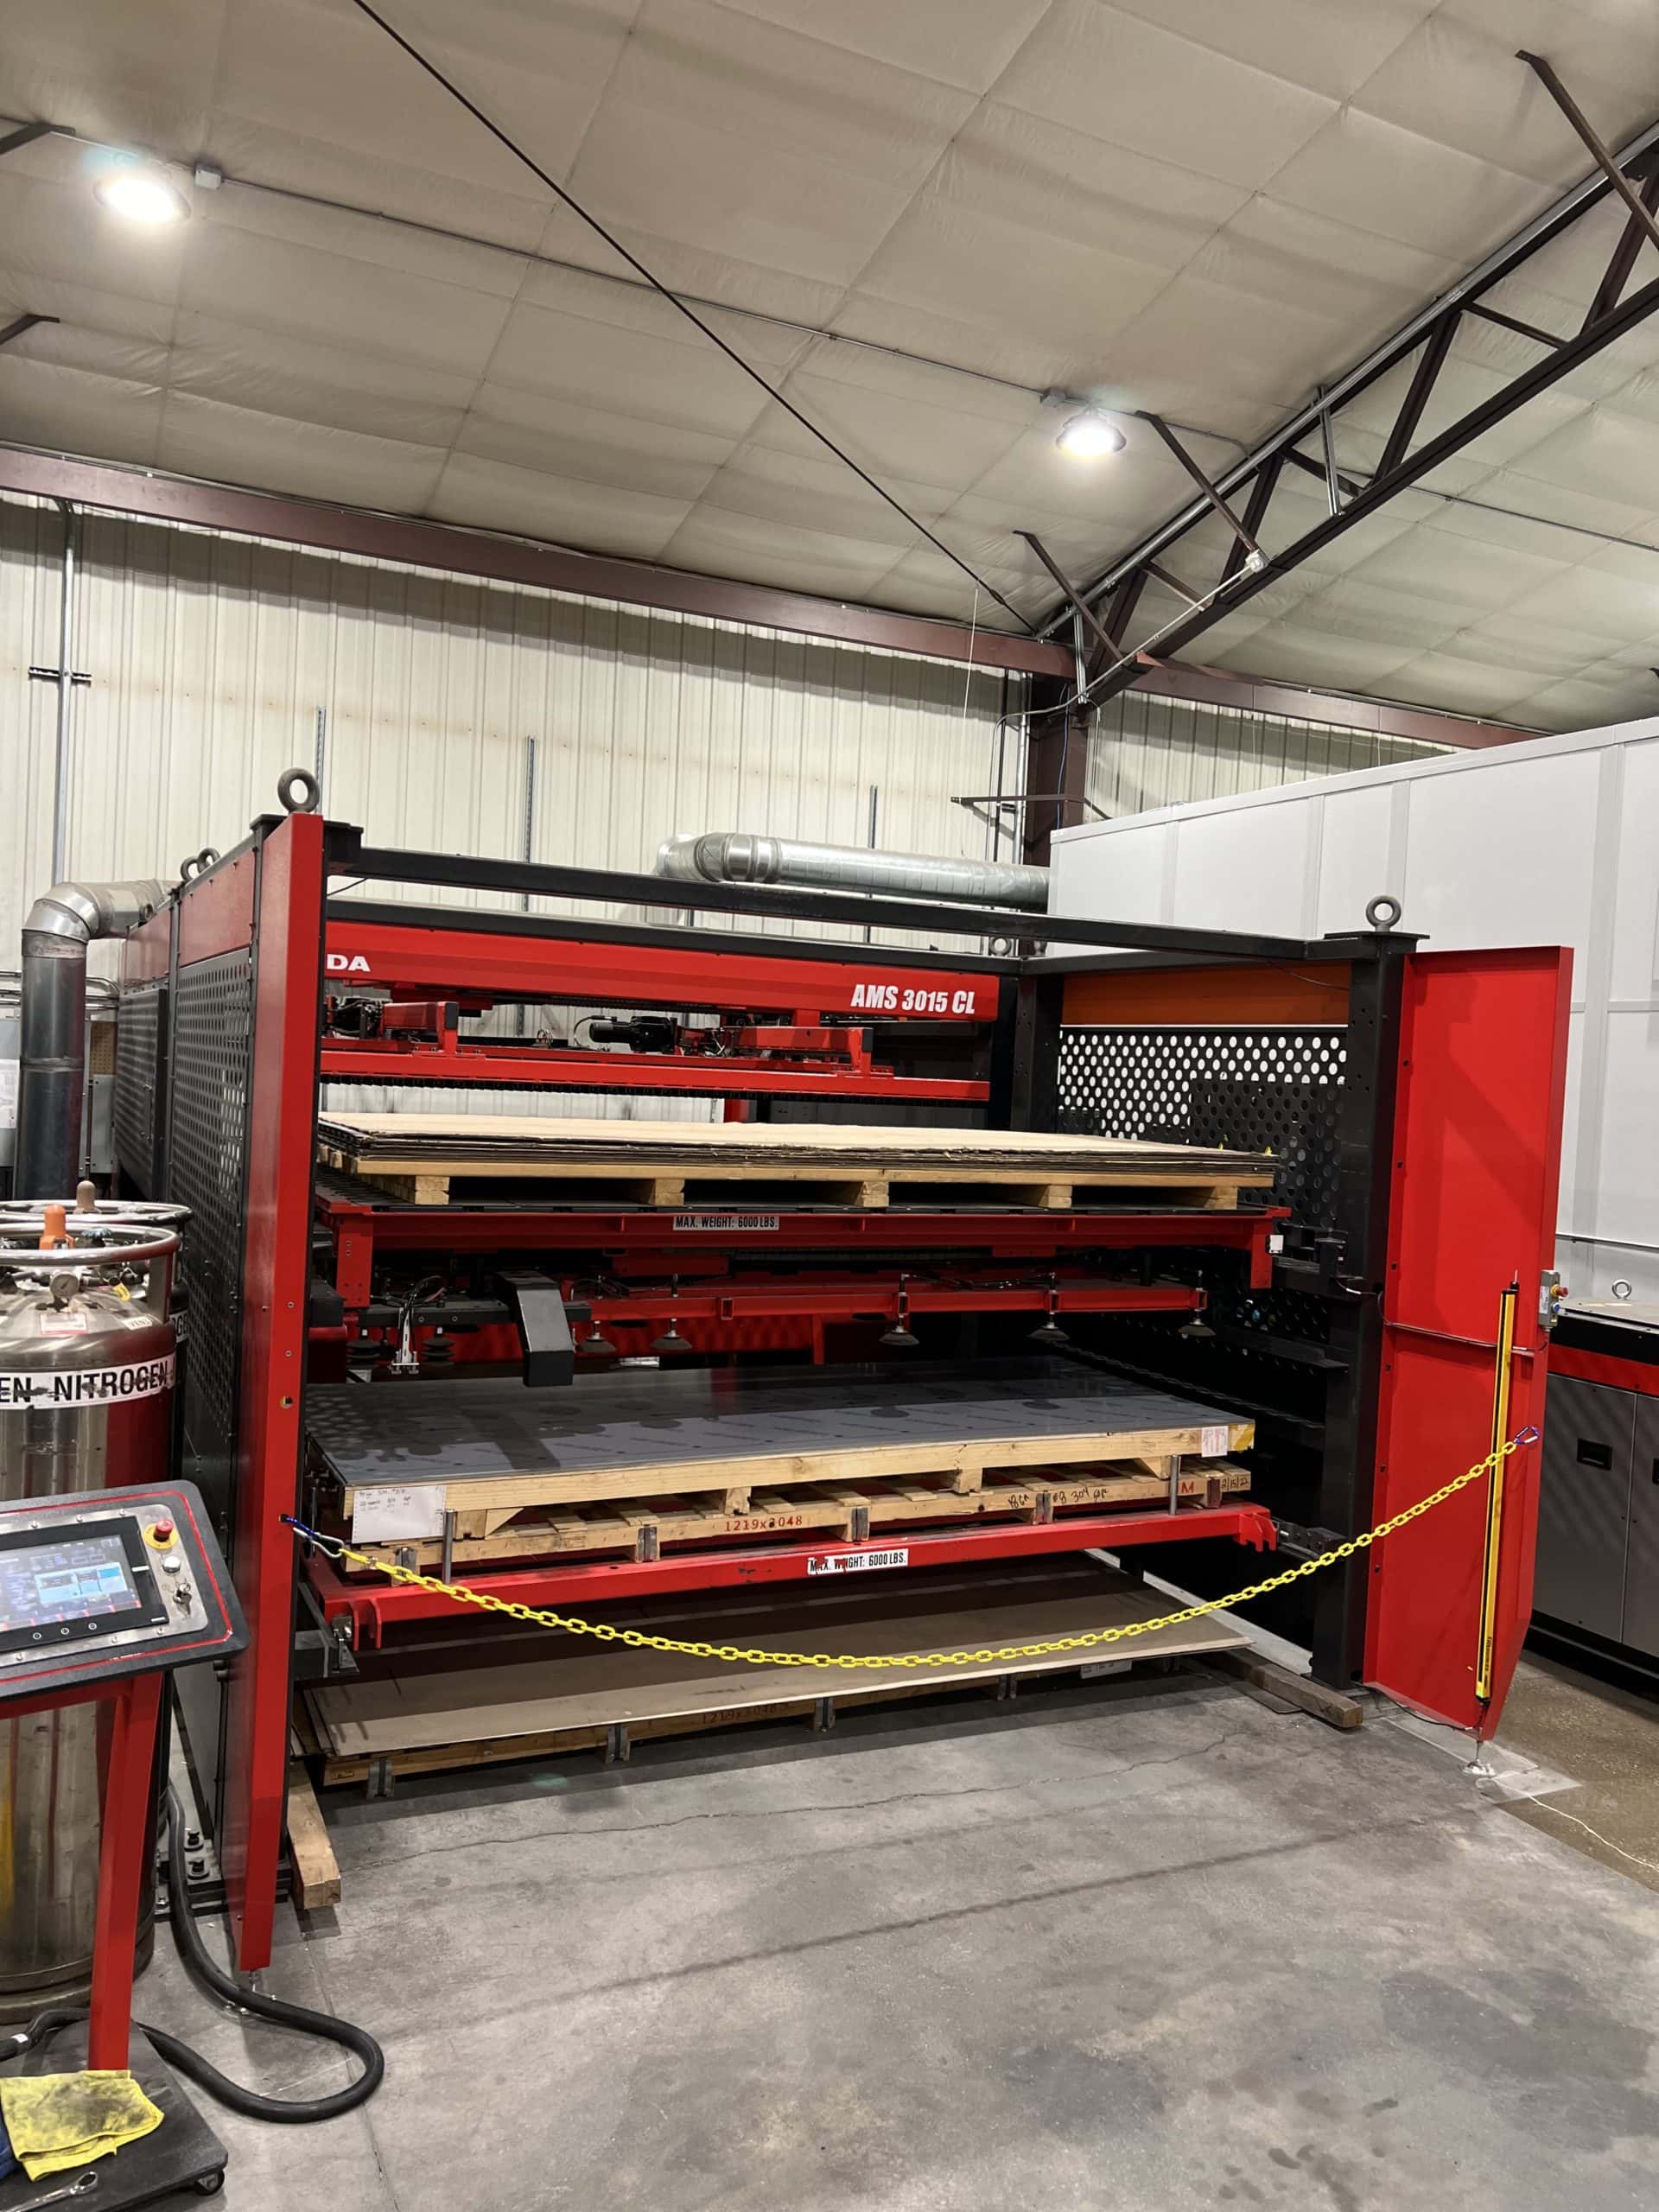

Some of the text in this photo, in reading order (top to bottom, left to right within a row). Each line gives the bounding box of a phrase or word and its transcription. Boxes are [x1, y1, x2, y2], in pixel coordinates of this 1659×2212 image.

[850, 984, 976, 1014] AMS 3015 CL
[676, 1217, 778, 1228] MAX. WEIGHT: 6000 LBS.
[0, 1361, 168, 1403] EN NITROGEN
[1181, 1480, 1195, 1494] M
[868, 1553, 888, 1567] 6000
[890, 1551, 906, 1565] LBS.
